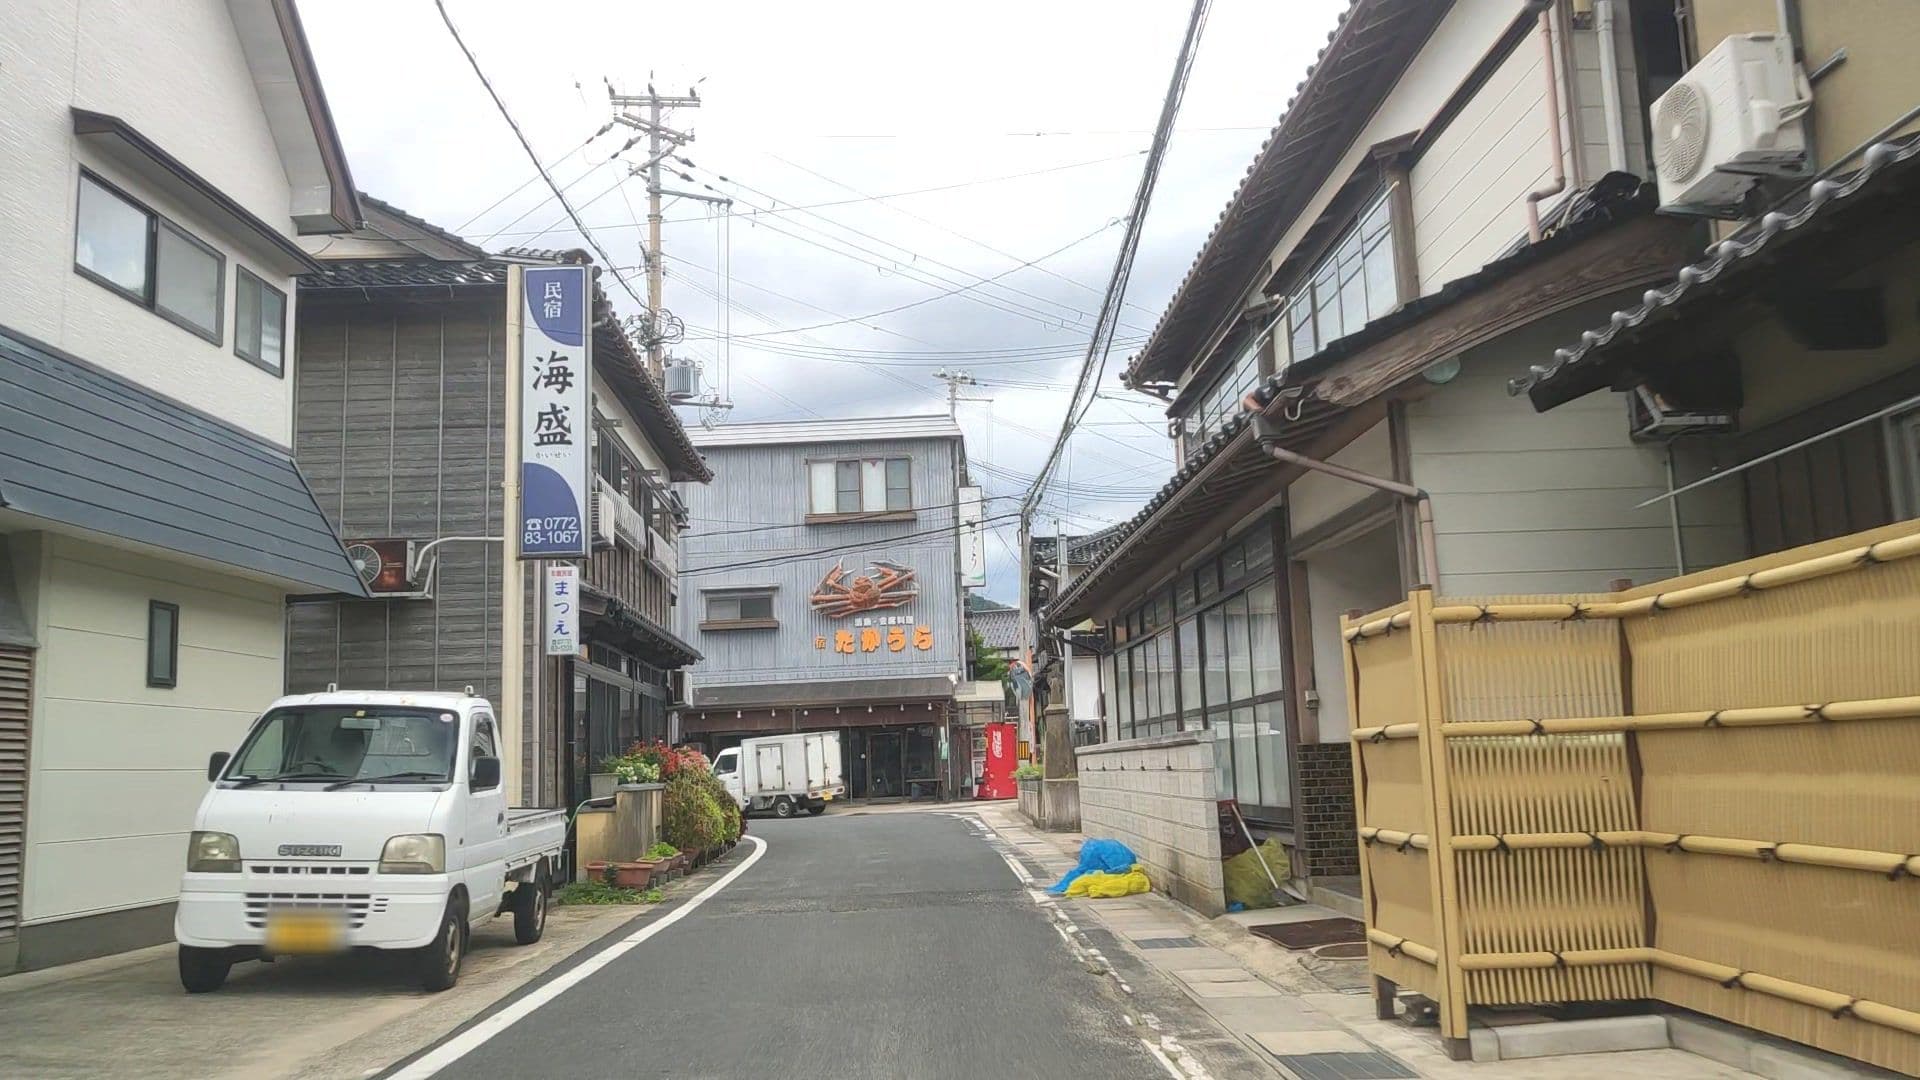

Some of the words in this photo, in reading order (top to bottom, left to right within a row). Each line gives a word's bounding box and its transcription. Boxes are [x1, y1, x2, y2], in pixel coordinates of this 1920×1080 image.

[544, 281, 562, 318] 民宿
[532, 350, 575, 447] 海盛
[524, 530, 580, 545] 83-1067
[544, 516, 578, 530] 0772
[554, 580, 570, 636] まつえ
[835, 626, 934, 655] たかうら
[279, 846, 342, 857] SUZUKI
